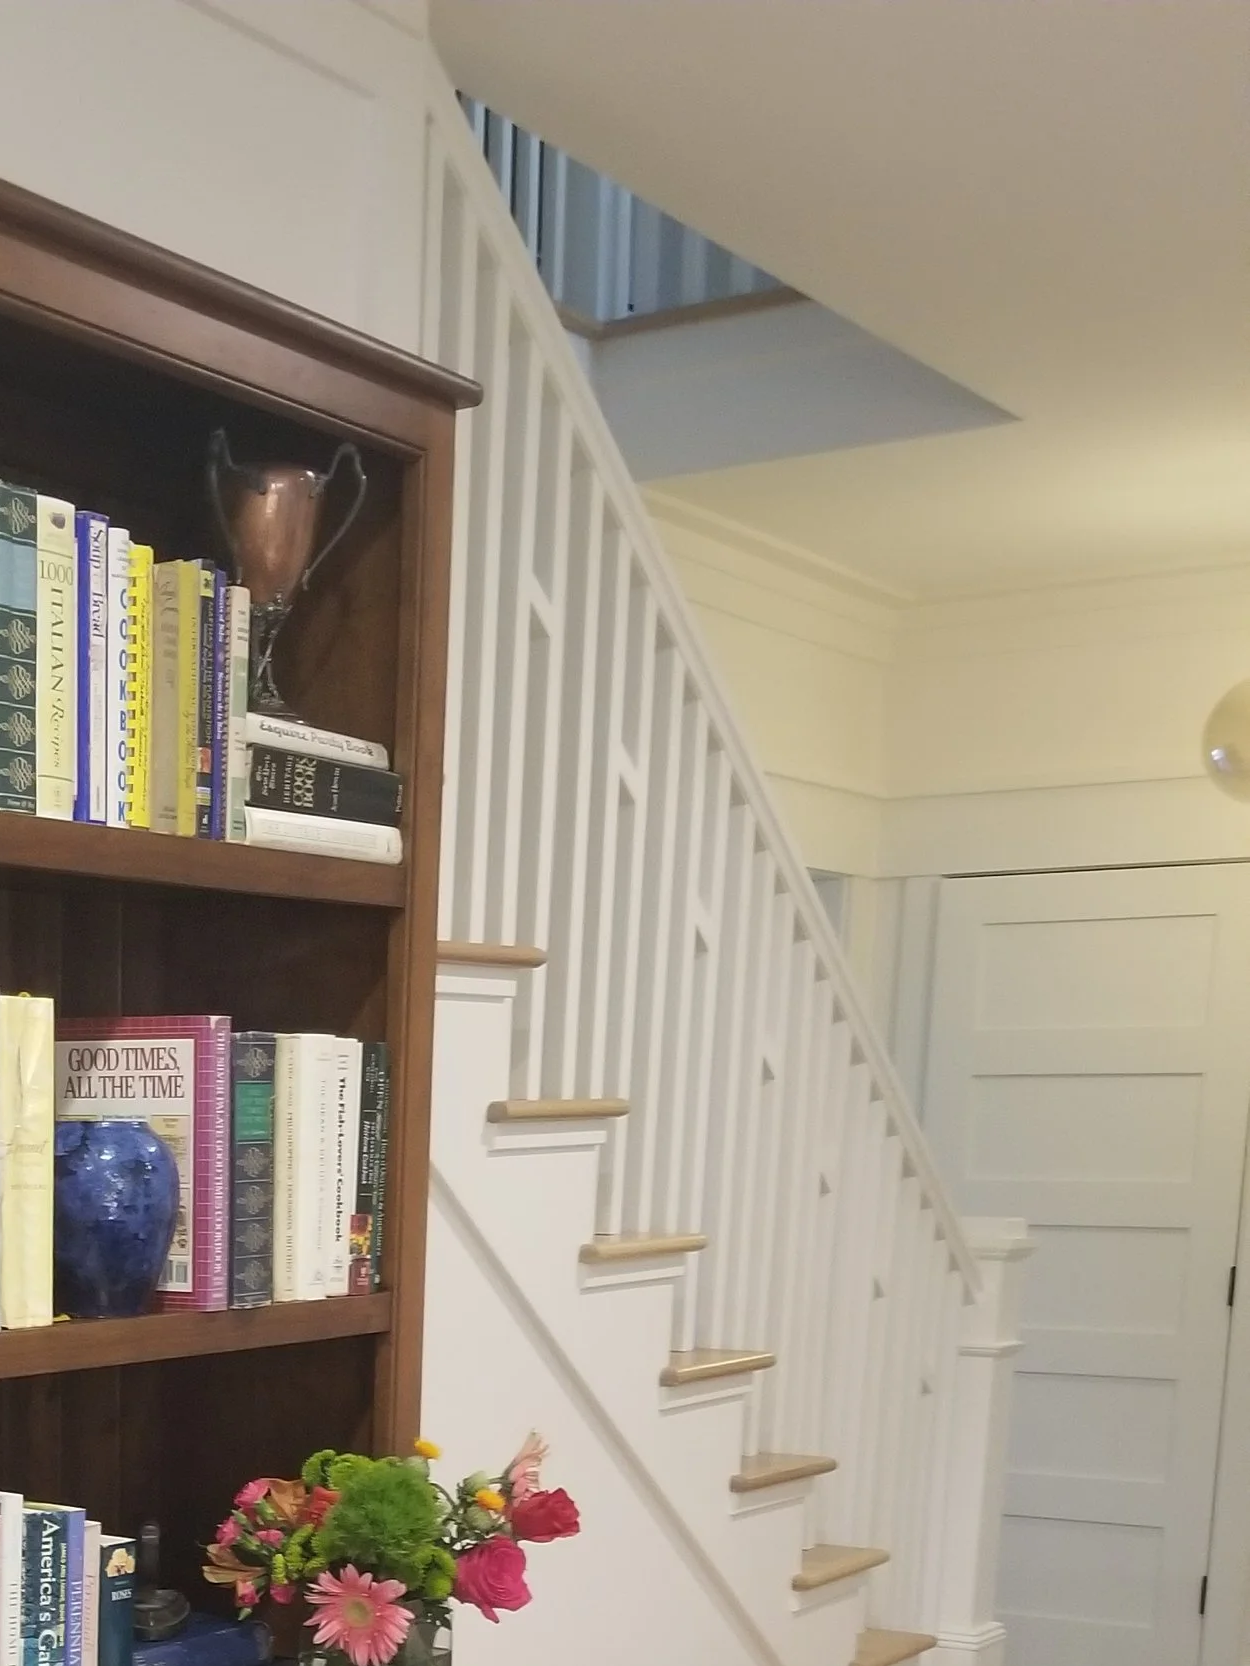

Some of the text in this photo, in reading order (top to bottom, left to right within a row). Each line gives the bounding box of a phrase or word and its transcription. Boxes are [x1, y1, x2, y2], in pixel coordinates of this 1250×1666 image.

[89, 528, 105, 569] Soup
[92, 591, 106, 638] Bread
[50, 588, 65, 693] ITALIAN
[50, 703, 65, 769] Recipes
[259, 720, 375, 758] Esquire Party Book
[282, 755, 295, 804] HERITAGE
[292, 758, 308, 807] COOK
[302, 759, 318, 808] BOOK
[68, 1046, 181, 1074] GOOD TIMES,
[64, 1075, 185, 1099] ALL THE TIME
[213, 1031, 226, 1274] THE SILVER PALATE GOOD TIMES COOKBOOK
[334, 1077, 347, 1243] The Fish-Lovers' Cookbook
[8, 1582, 19, 1607] THE
[38, 1519, 62, 1622] America's
[111, 1588, 133, 1601] ROSES
[8, 1615, 18, 1656] HOME
